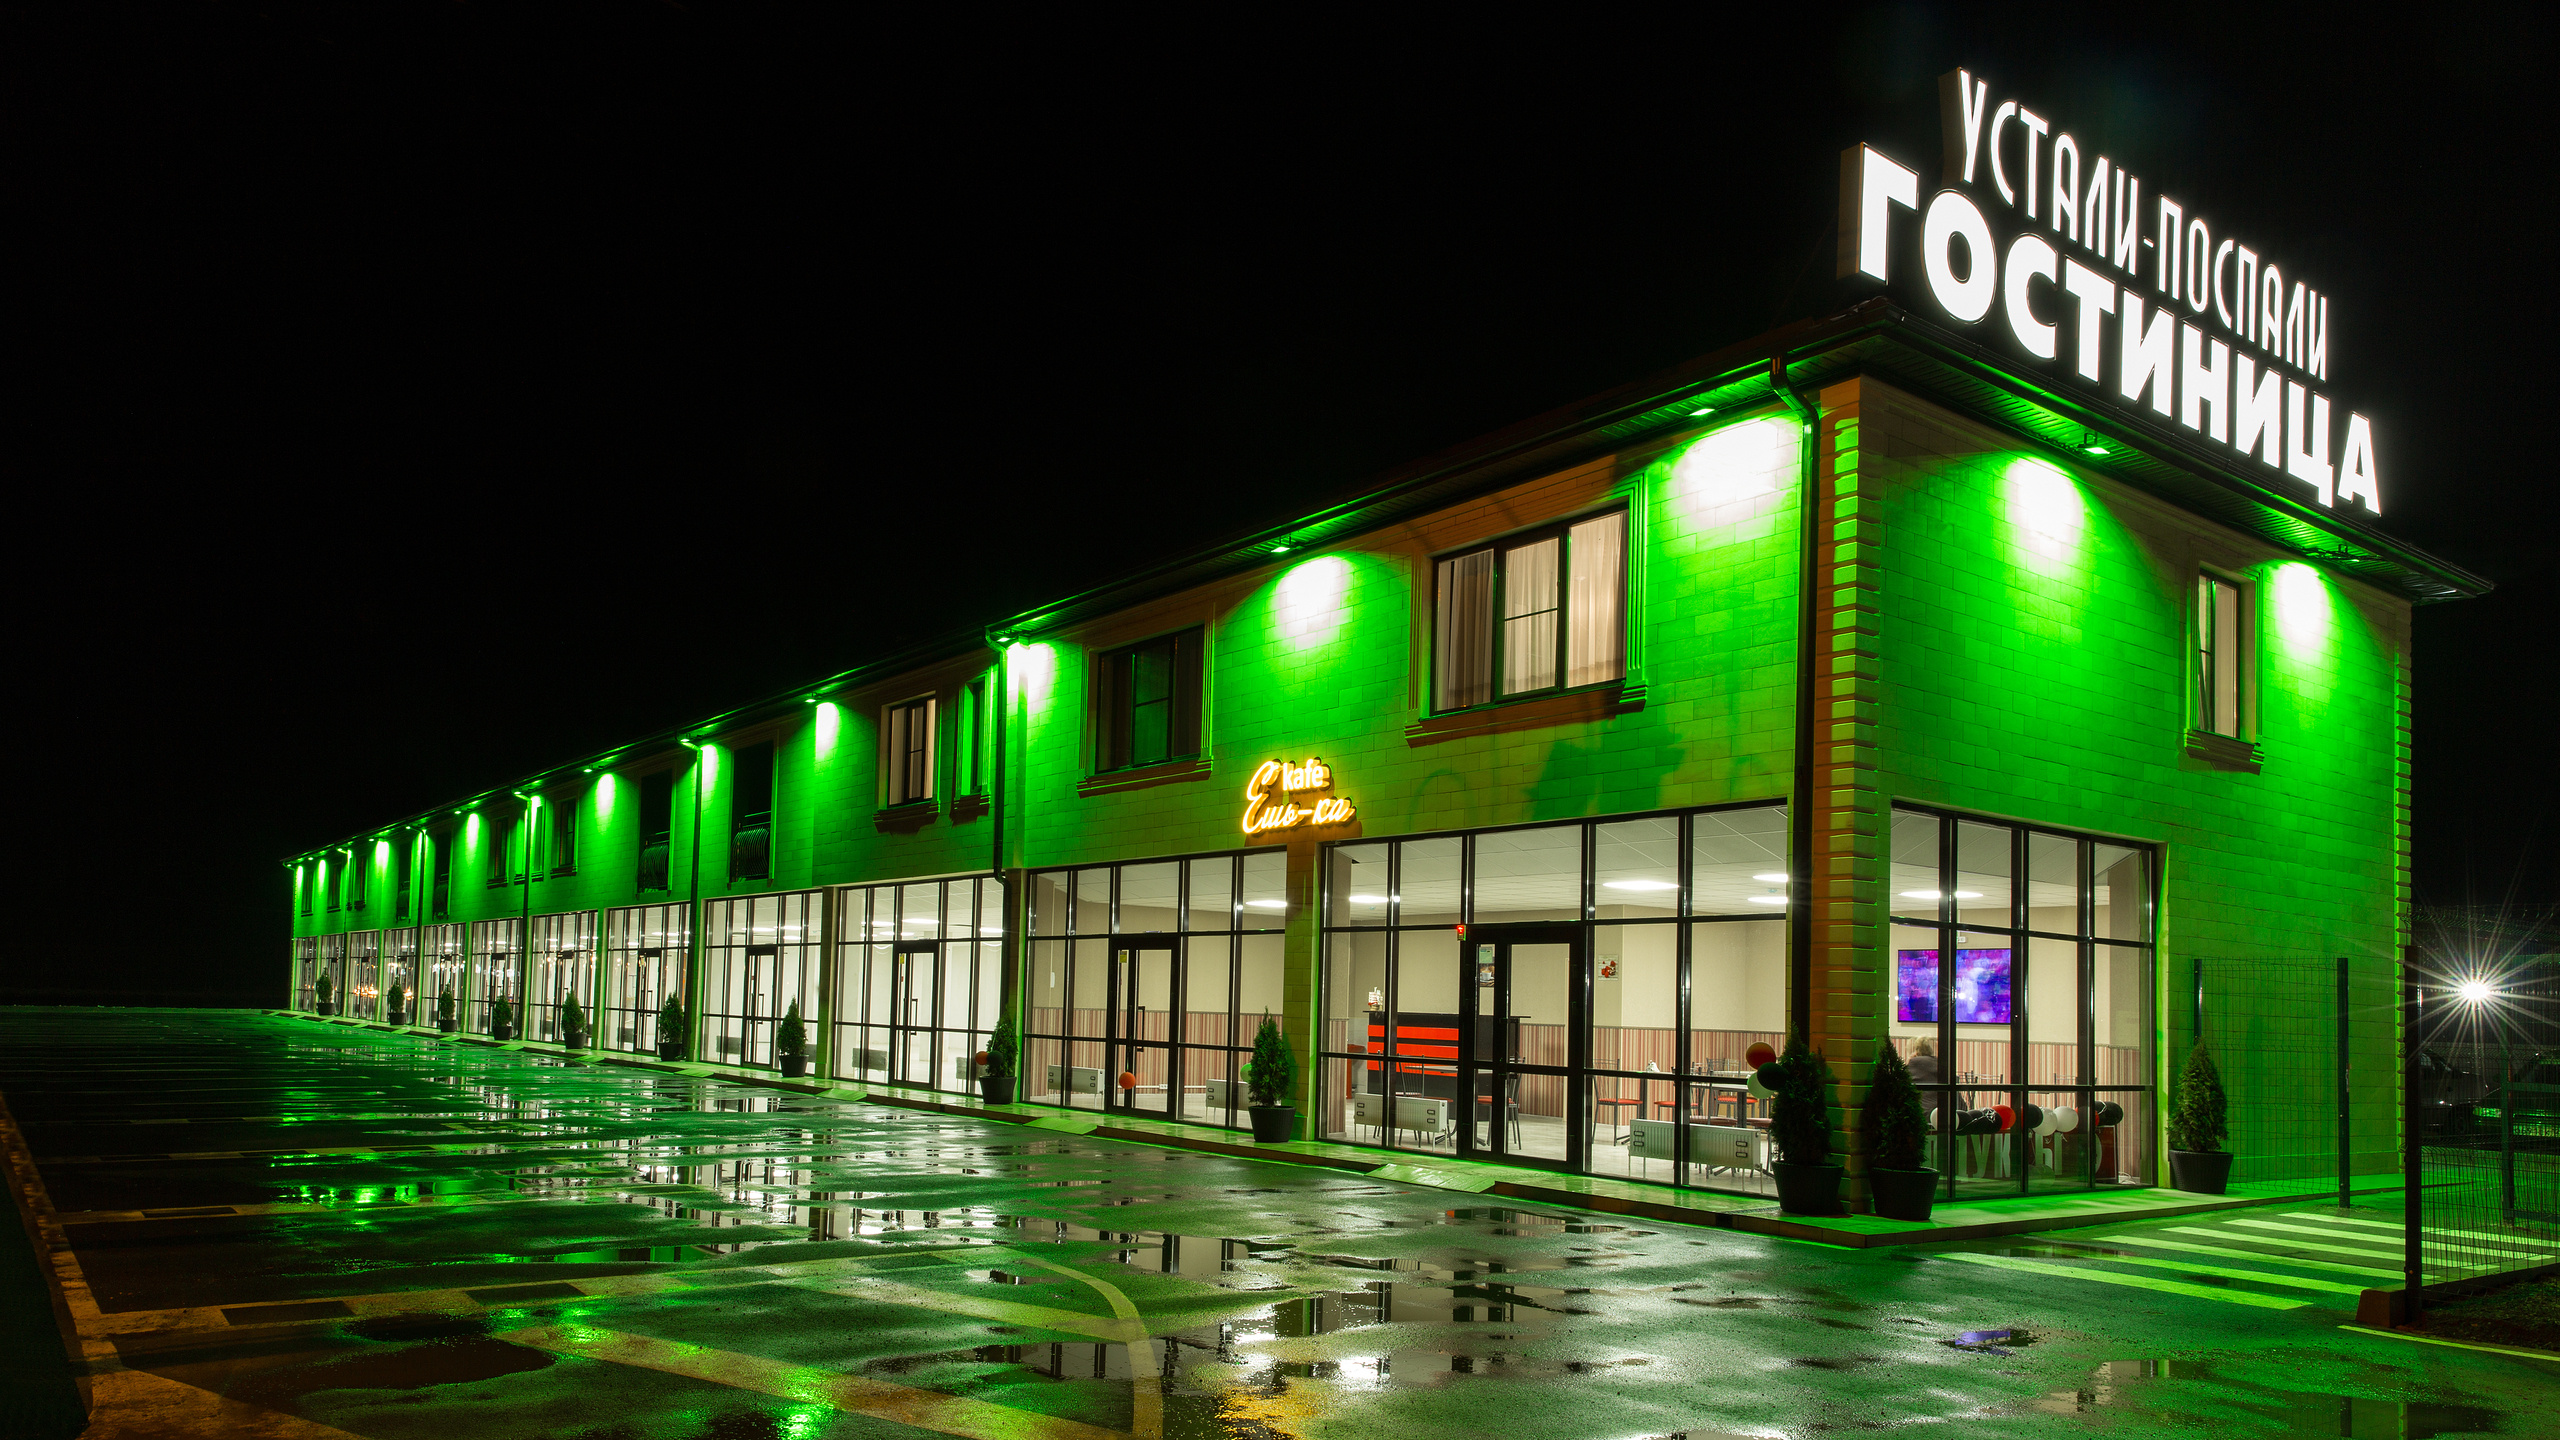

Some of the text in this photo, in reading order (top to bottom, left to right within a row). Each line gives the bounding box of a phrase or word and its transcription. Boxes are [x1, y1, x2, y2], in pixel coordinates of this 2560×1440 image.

[1956, 66, 2328, 383] УСТАЛИ-ПОСПАЛИ
[1856, 141, 2383, 517] ГОСТИНИЦА
[1242, 759, 1354, 834] Ешь-ка
[1282, 757, 1330, 791] kafe
